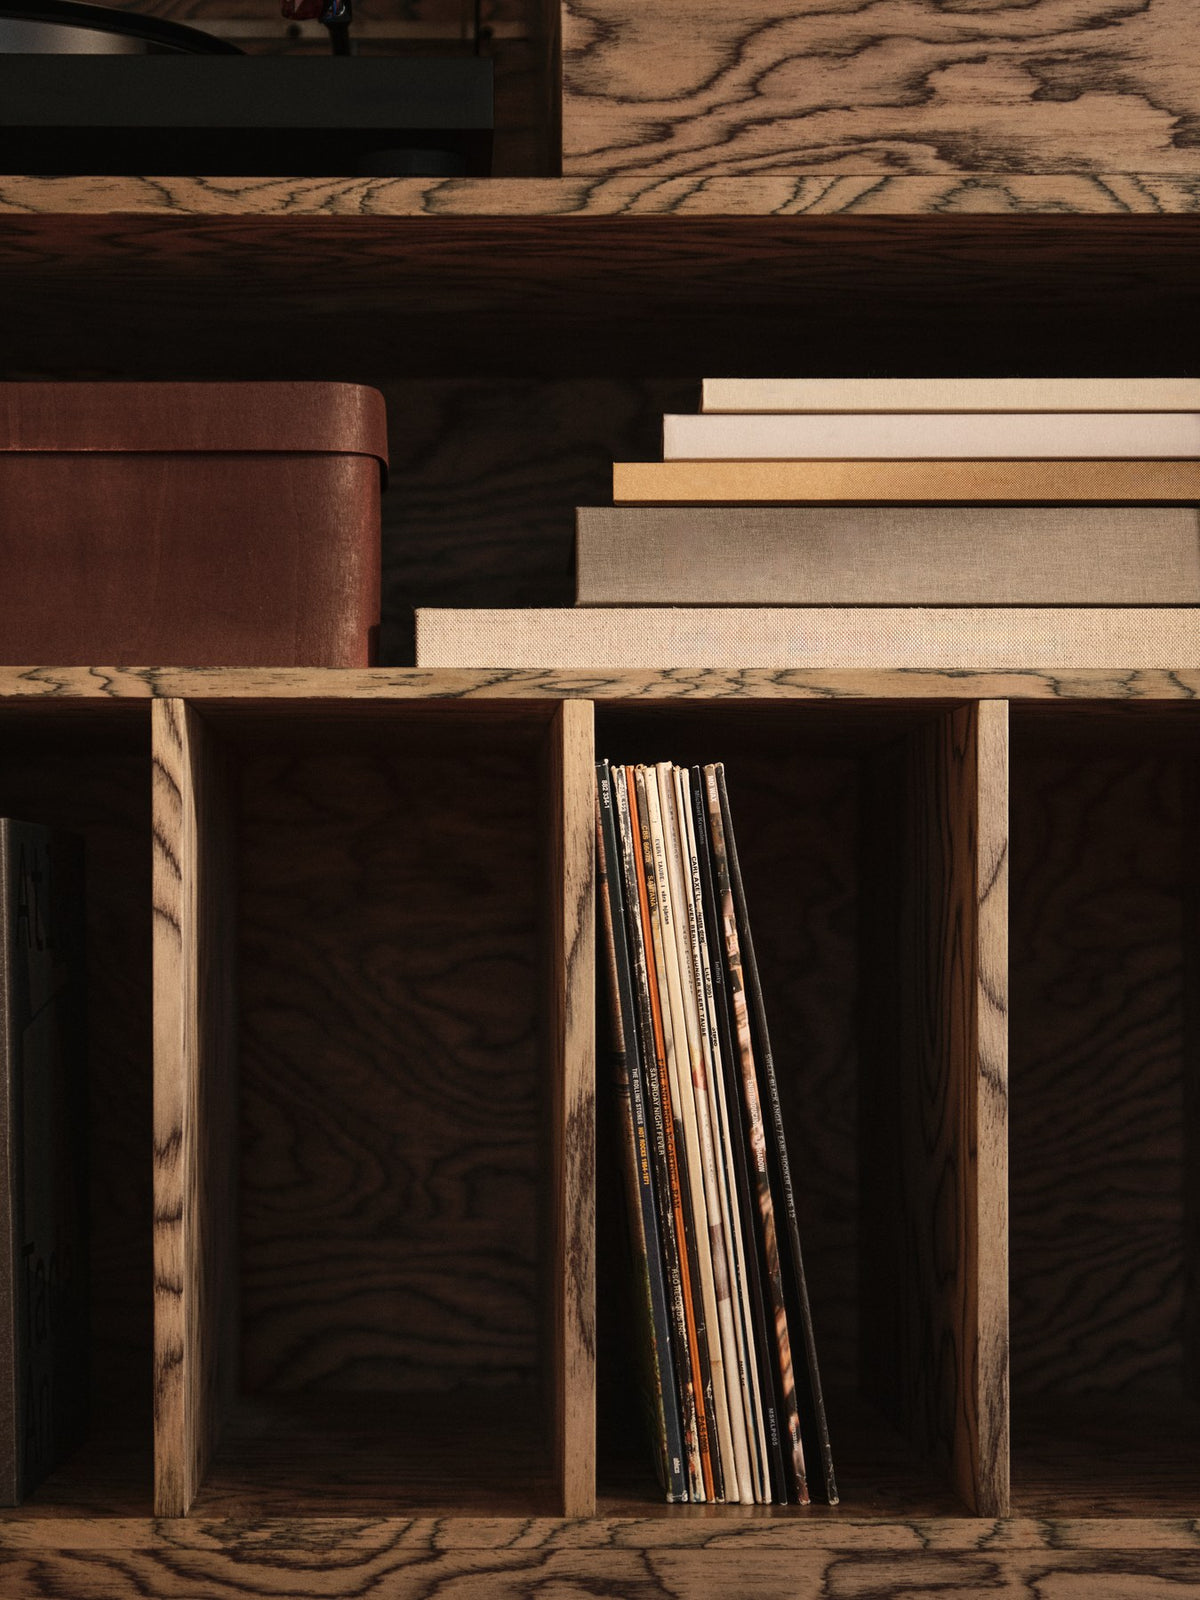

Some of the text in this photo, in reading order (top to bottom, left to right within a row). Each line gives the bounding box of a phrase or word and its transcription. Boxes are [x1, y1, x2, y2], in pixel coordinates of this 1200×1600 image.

[693, 789, 702, 815] Michael
[708, 786, 717, 802] WAX
[654, 838, 662, 857] EVERT
[640, 824, 649, 840] CBS
[645, 874, 656, 907] SANTANA
[690, 855, 698, 875] CARL
[687, 903, 695, 922] SVEN
[692, 953, 701, 987] SJUNGER
[713, 960, 722, 984] Infinity
[696, 989, 704, 1011] EVERT
[698, 1013, 706, 1037] TAUBE
[630, 1067, 638, 1078] THE
[655, 1058, 666, 1083] PAUL
[632, 1079, 641, 1102] ROLLING
[658, 1084, 668, 1102] AND
[767, 1078, 778, 1102] BLACK
[634, 1103, 643, 1125] STONES
[648, 1067, 665, 1156] SATURDAY NIGHT FEVER
[660, 1102, 671, 1130] LINDA
[771, 1103, 782, 1127] ANGEL
[637, 1126, 645, 1138] HOT
[776, 1134, 786, 1153] EARL
[638, 1138, 647, 1157] ROCKS
[754, 1143, 765, 1173] SHADOW
[779, 1154, 791, 1185] HOOKER
[670, 1188, 680, 1209] RAM
[672, 1284, 683, 1321] RECORDS
